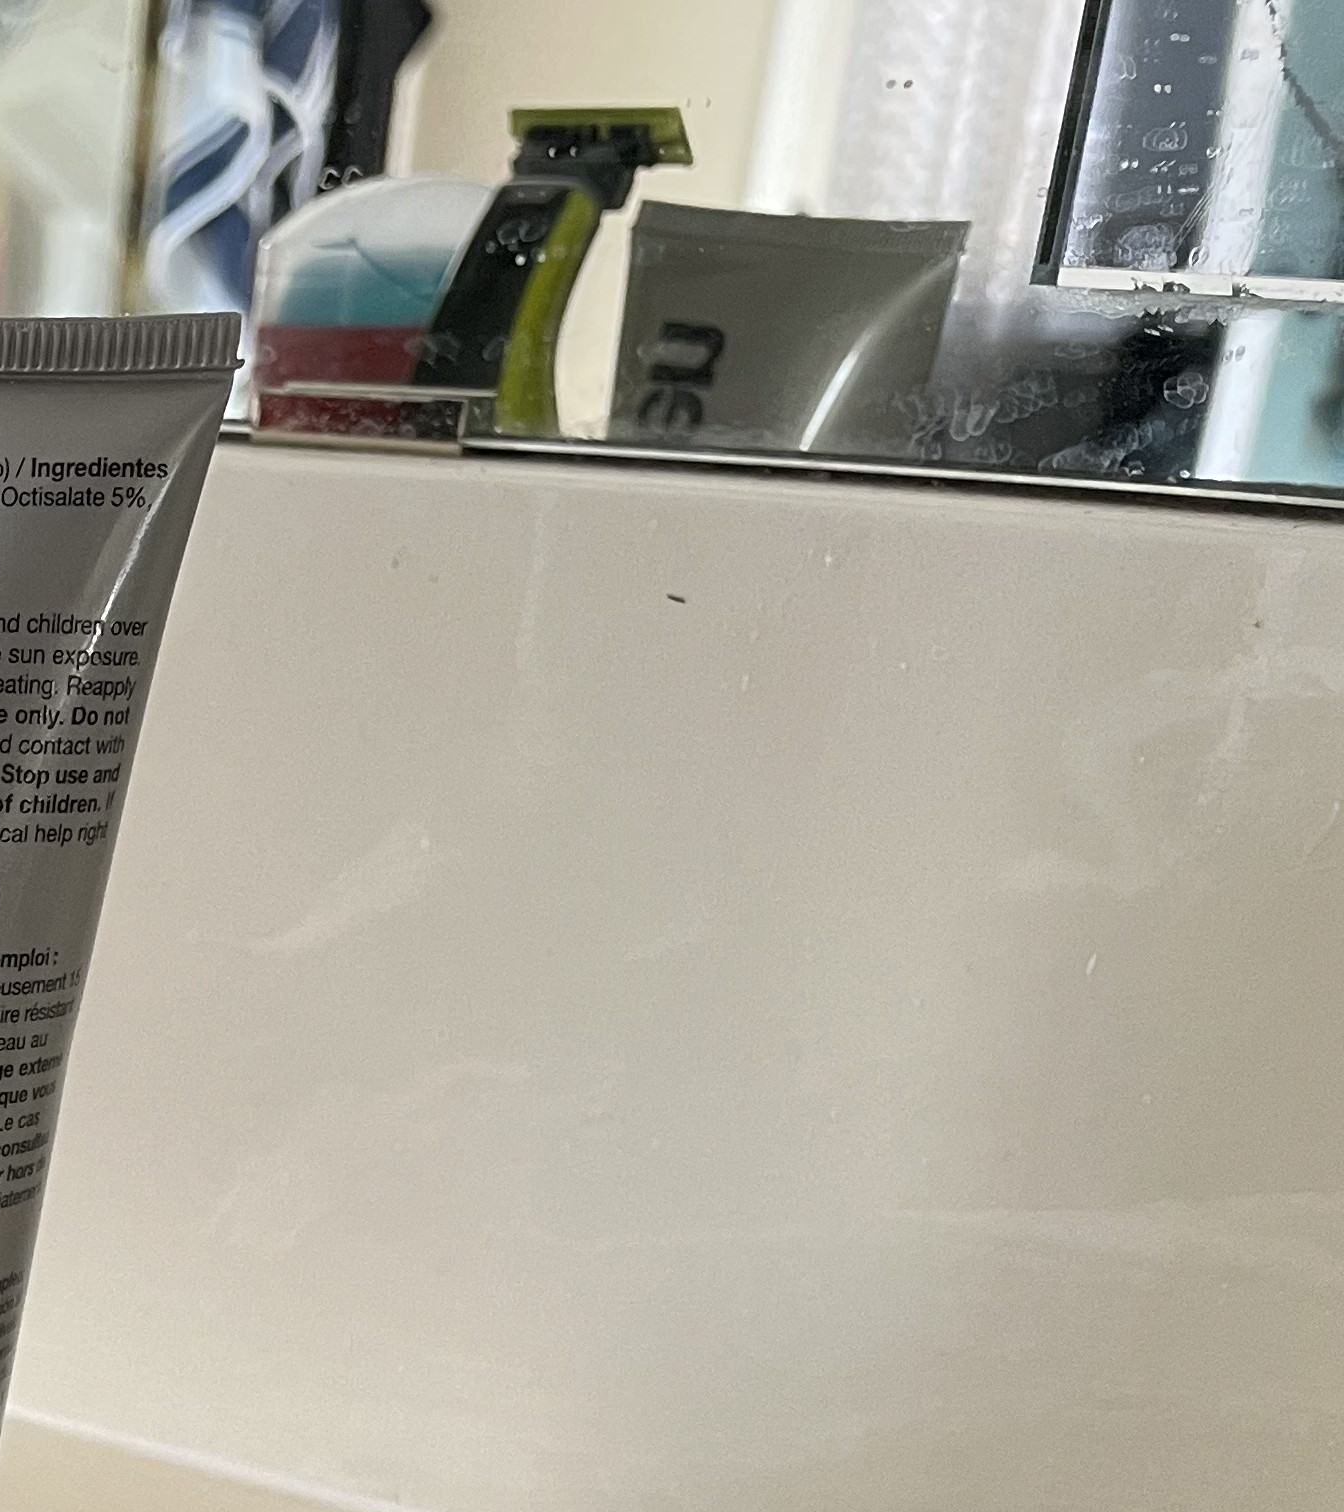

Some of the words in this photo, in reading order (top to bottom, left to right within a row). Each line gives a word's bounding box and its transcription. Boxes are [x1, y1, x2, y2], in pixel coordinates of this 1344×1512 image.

[31, 458, 168, 482] Ingredientes
[1, 486, 105, 507] Octisalate
[111, 486, 153, 512] 5%,
[27, 613, 108, 634] children
[107, 614, 148, 636] over
